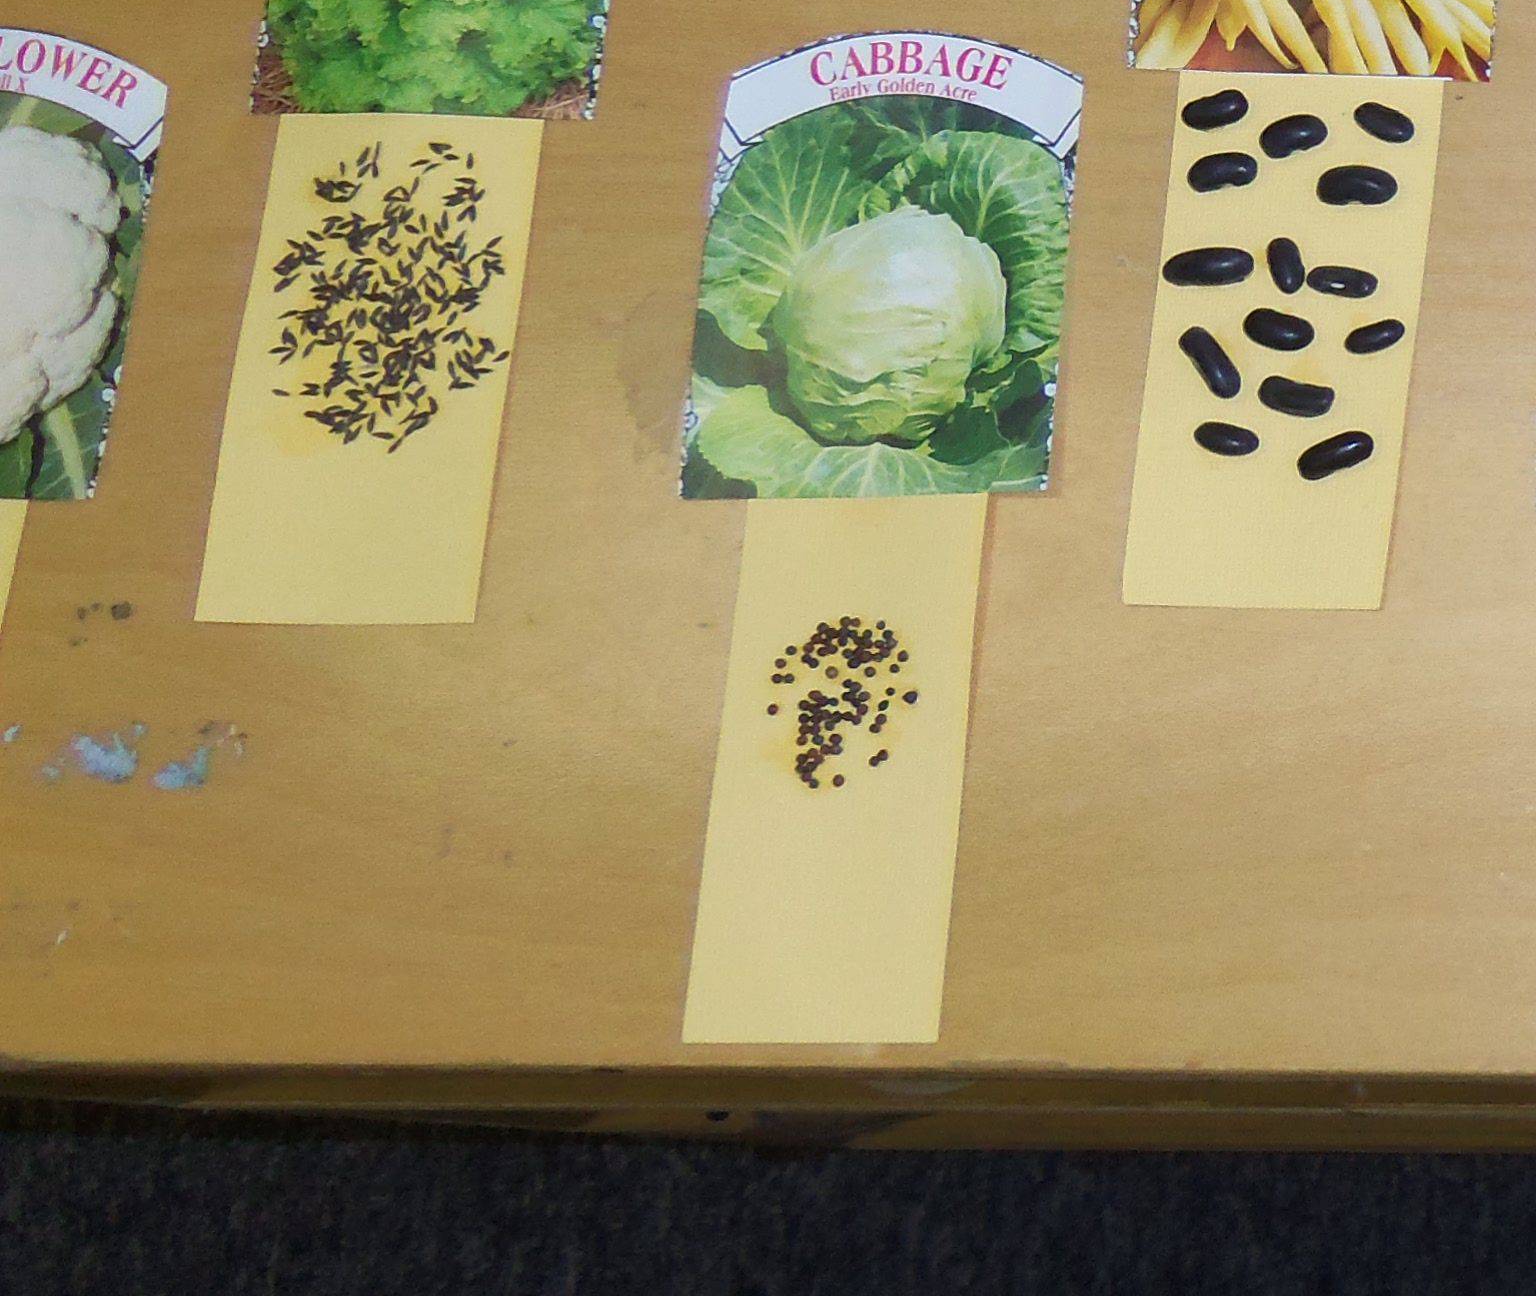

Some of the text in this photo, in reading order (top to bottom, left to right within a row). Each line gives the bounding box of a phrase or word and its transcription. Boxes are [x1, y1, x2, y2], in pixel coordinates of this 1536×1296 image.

[809, 40, 1013, 91] CABBAGE
[829, 77, 978, 103] Early Golden Acre
